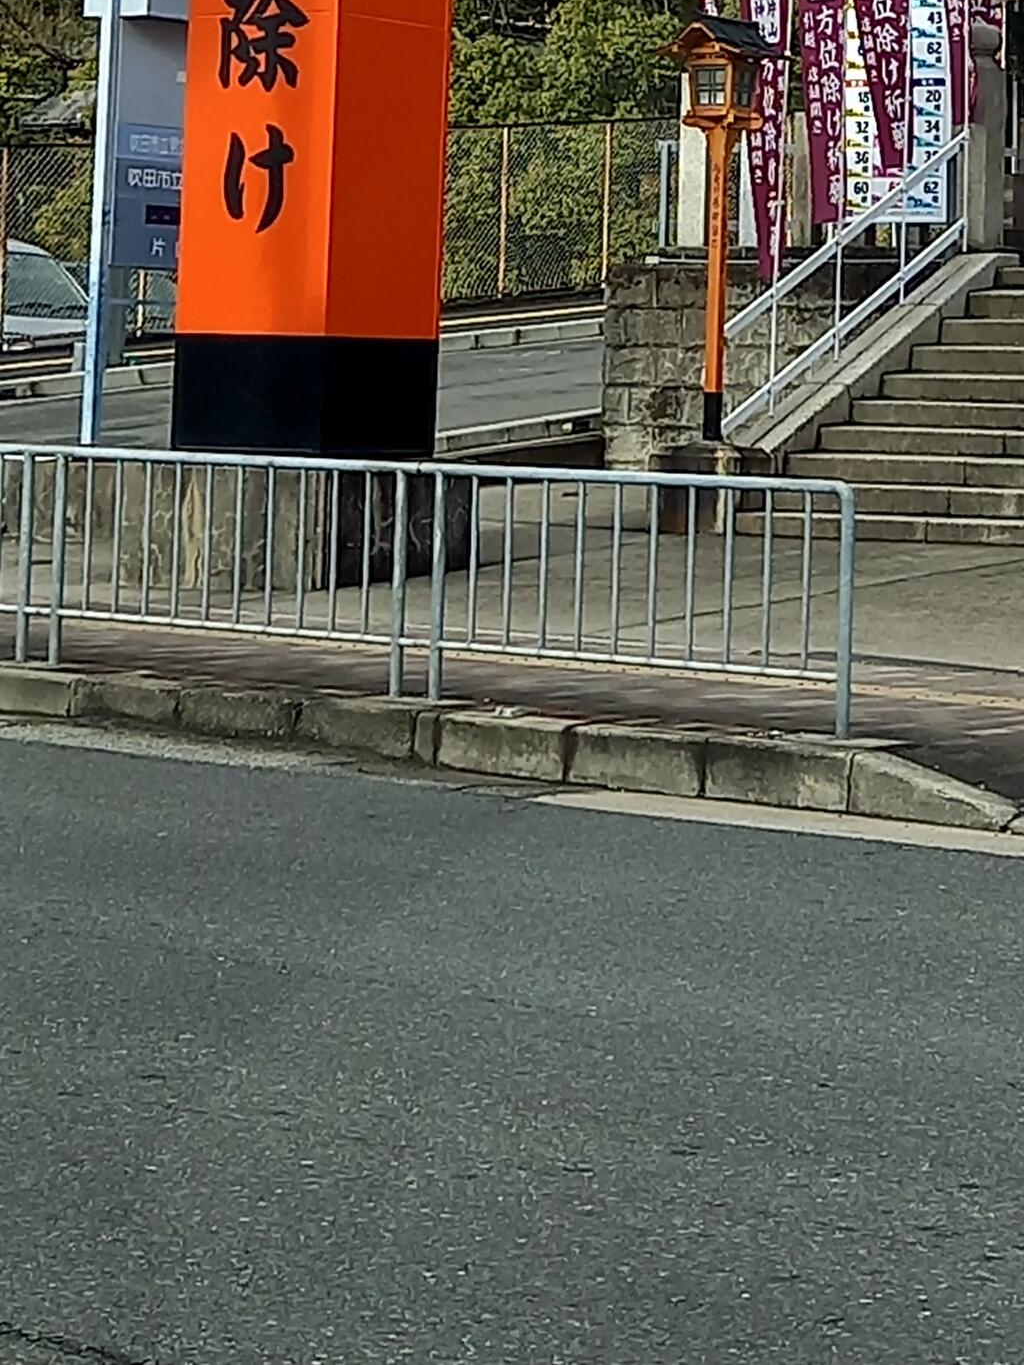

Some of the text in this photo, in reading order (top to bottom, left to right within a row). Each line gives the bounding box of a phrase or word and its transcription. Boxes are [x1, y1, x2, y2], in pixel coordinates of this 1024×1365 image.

[925, 90, 942, 103] 20
[855, 121, 869, 134] 32
[924, 120, 940, 133] 34
[127, 167, 183, 190] 吹田市立
[853, 181, 869, 194] 60
[923, 181, 939, 194] 62
